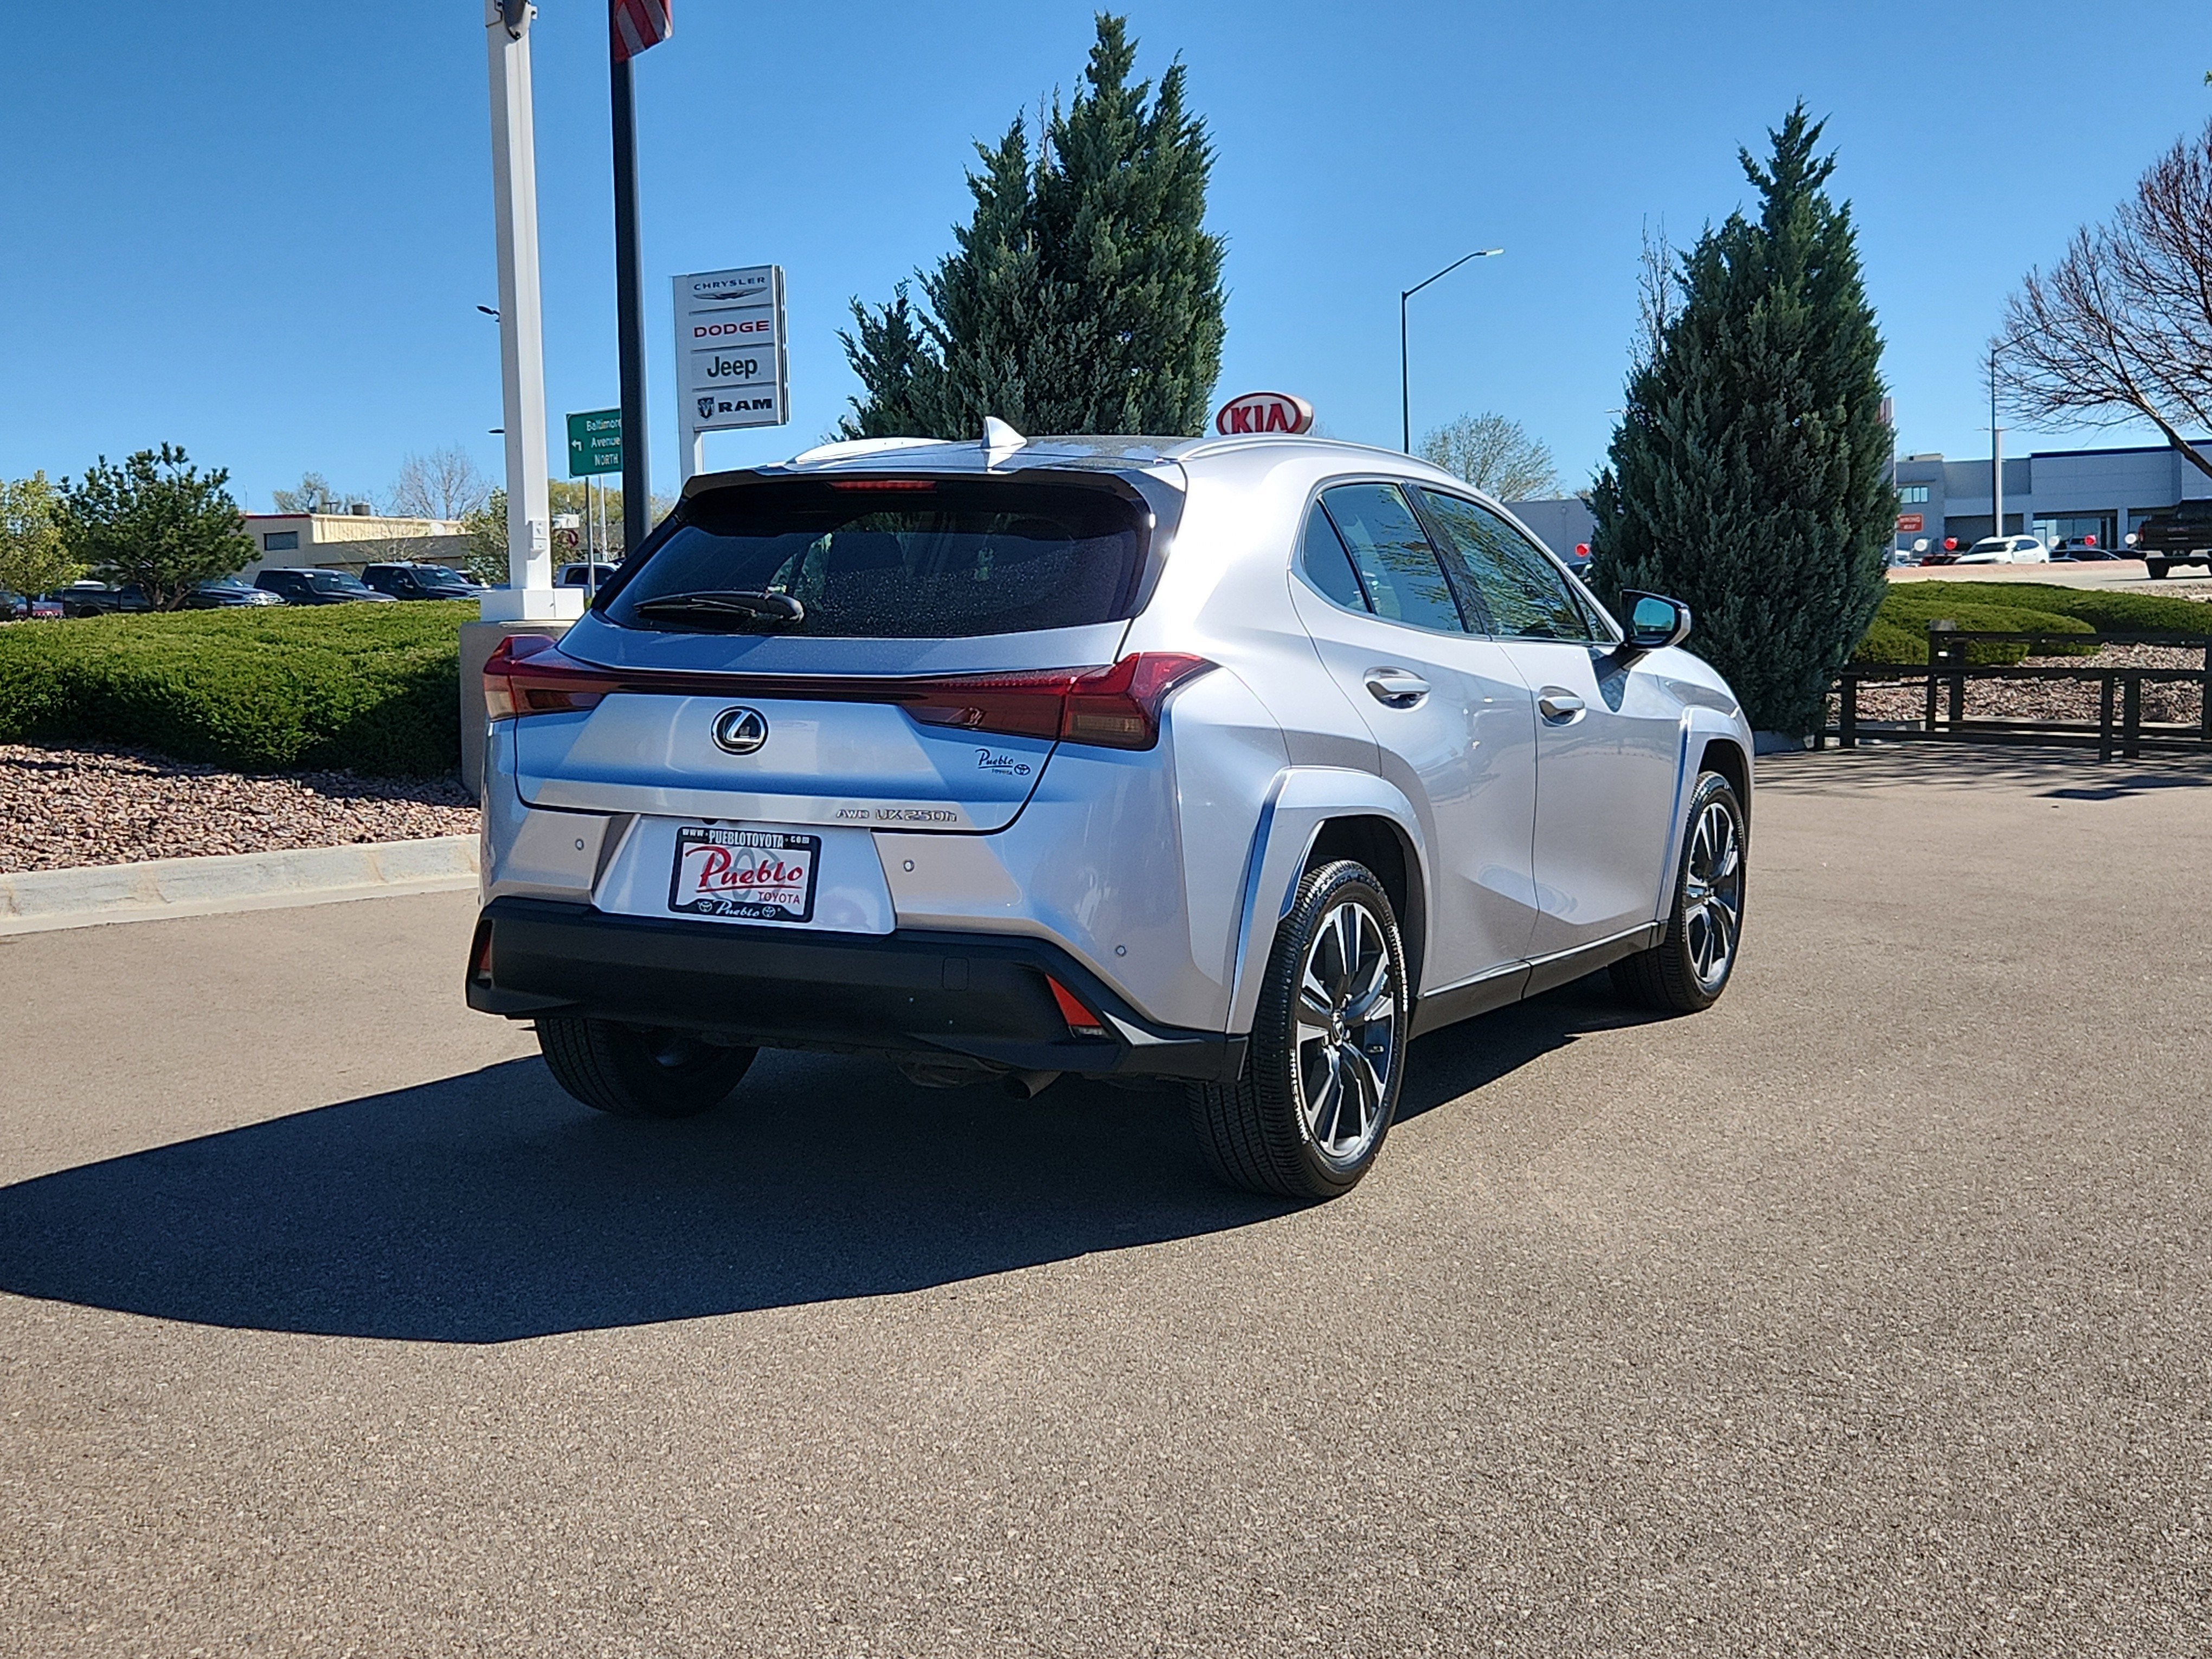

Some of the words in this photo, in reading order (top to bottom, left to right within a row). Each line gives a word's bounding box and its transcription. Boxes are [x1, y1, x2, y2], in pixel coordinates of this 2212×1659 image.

[693, 276, 766, 290] CHRYSLER
[693, 320, 770, 338] DODGE
[707, 356, 757, 379] Jeep
[718, 398, 773, 413] RAM
[1230, 403, 1288, 434] KIA
[591, 436, 621, 448] Avenue
[595, 453, 619, 466] NORTH
[975, 748, 1013, 766] Pueblo
[836, 809, 870, 819] AWD
[685, 846, 803, 888] Pueblo
[758, 891, 800, 904] TOYOTA
[713, 899, 760, 917] Pueblo
